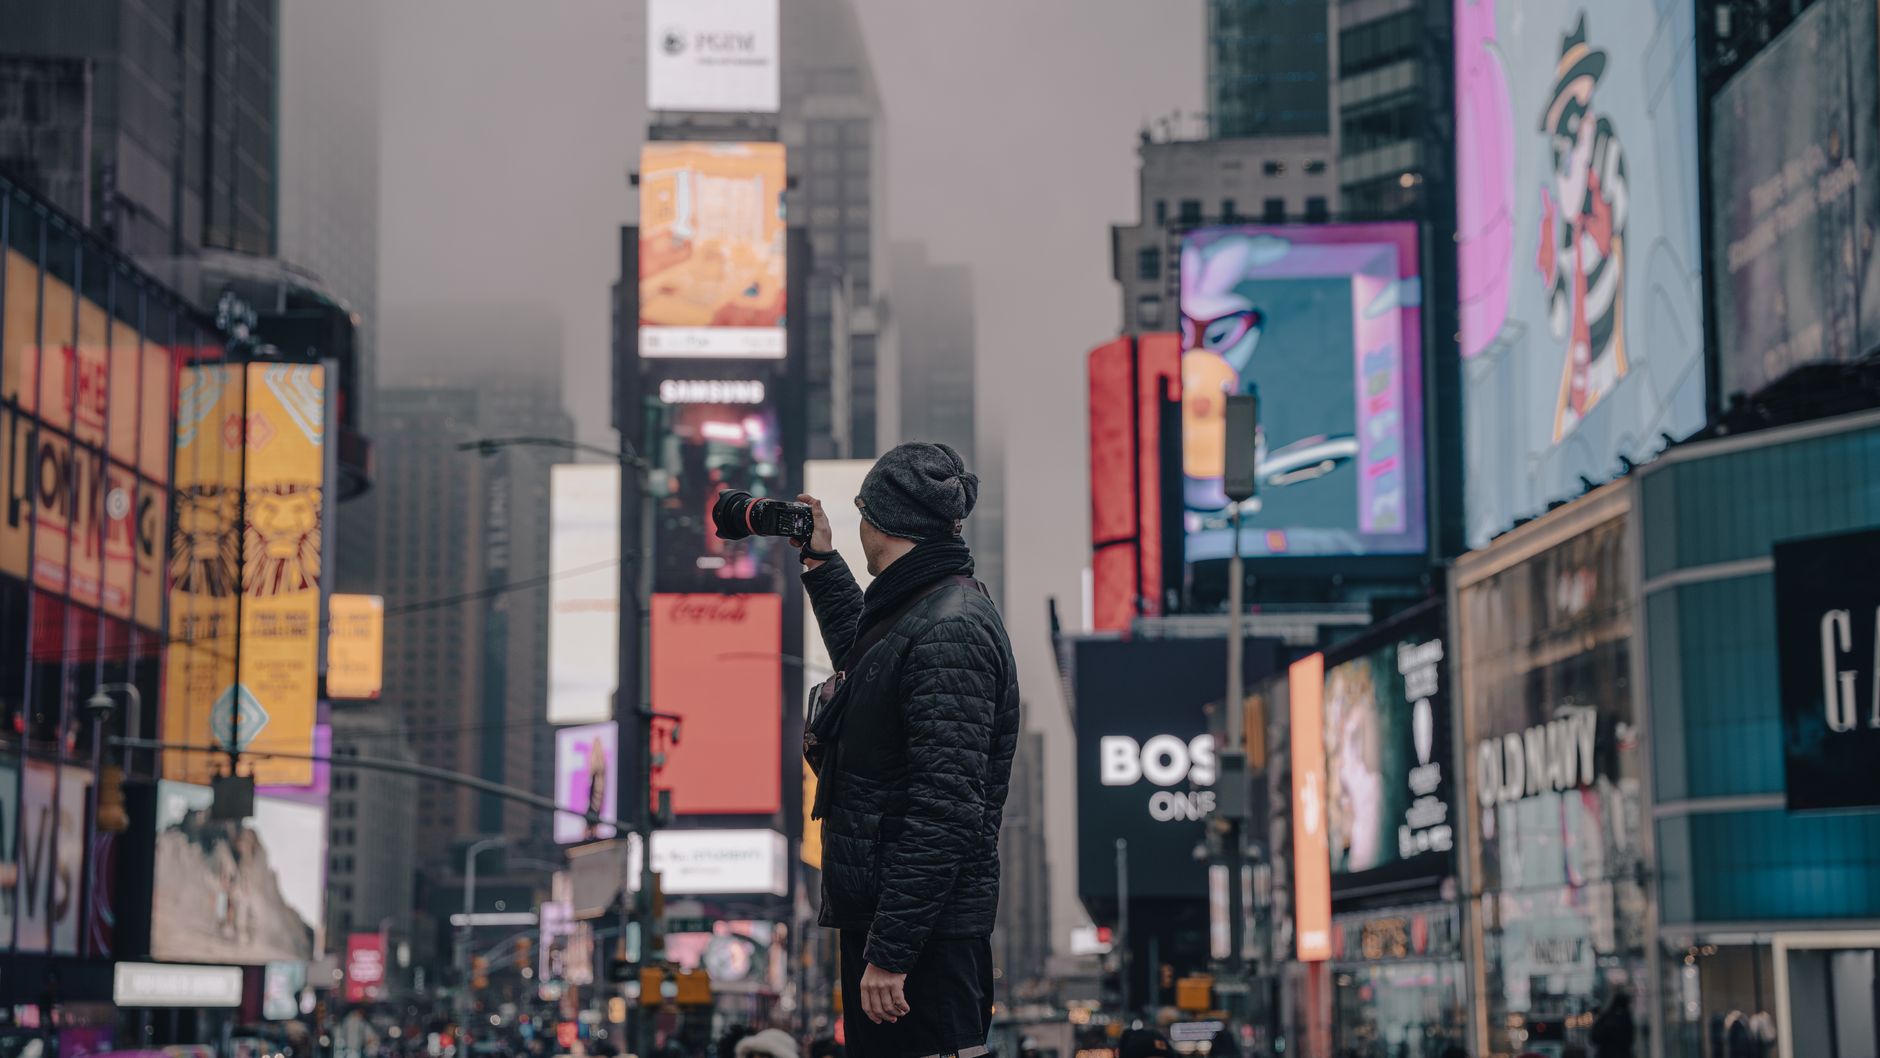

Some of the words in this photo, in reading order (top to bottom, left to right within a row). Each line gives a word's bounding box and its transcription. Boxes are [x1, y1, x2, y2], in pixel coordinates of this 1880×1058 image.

[62, 343, 106, 418] THE
[660, 379, 765, 404] SAMSUNG
[1100, 733, 1216, 787] BOS
[1477, 732, 1526, 808] OLD
[1524, 704, 1597, 796] NAVY
[1148, 790, 1217, 822] ONE
